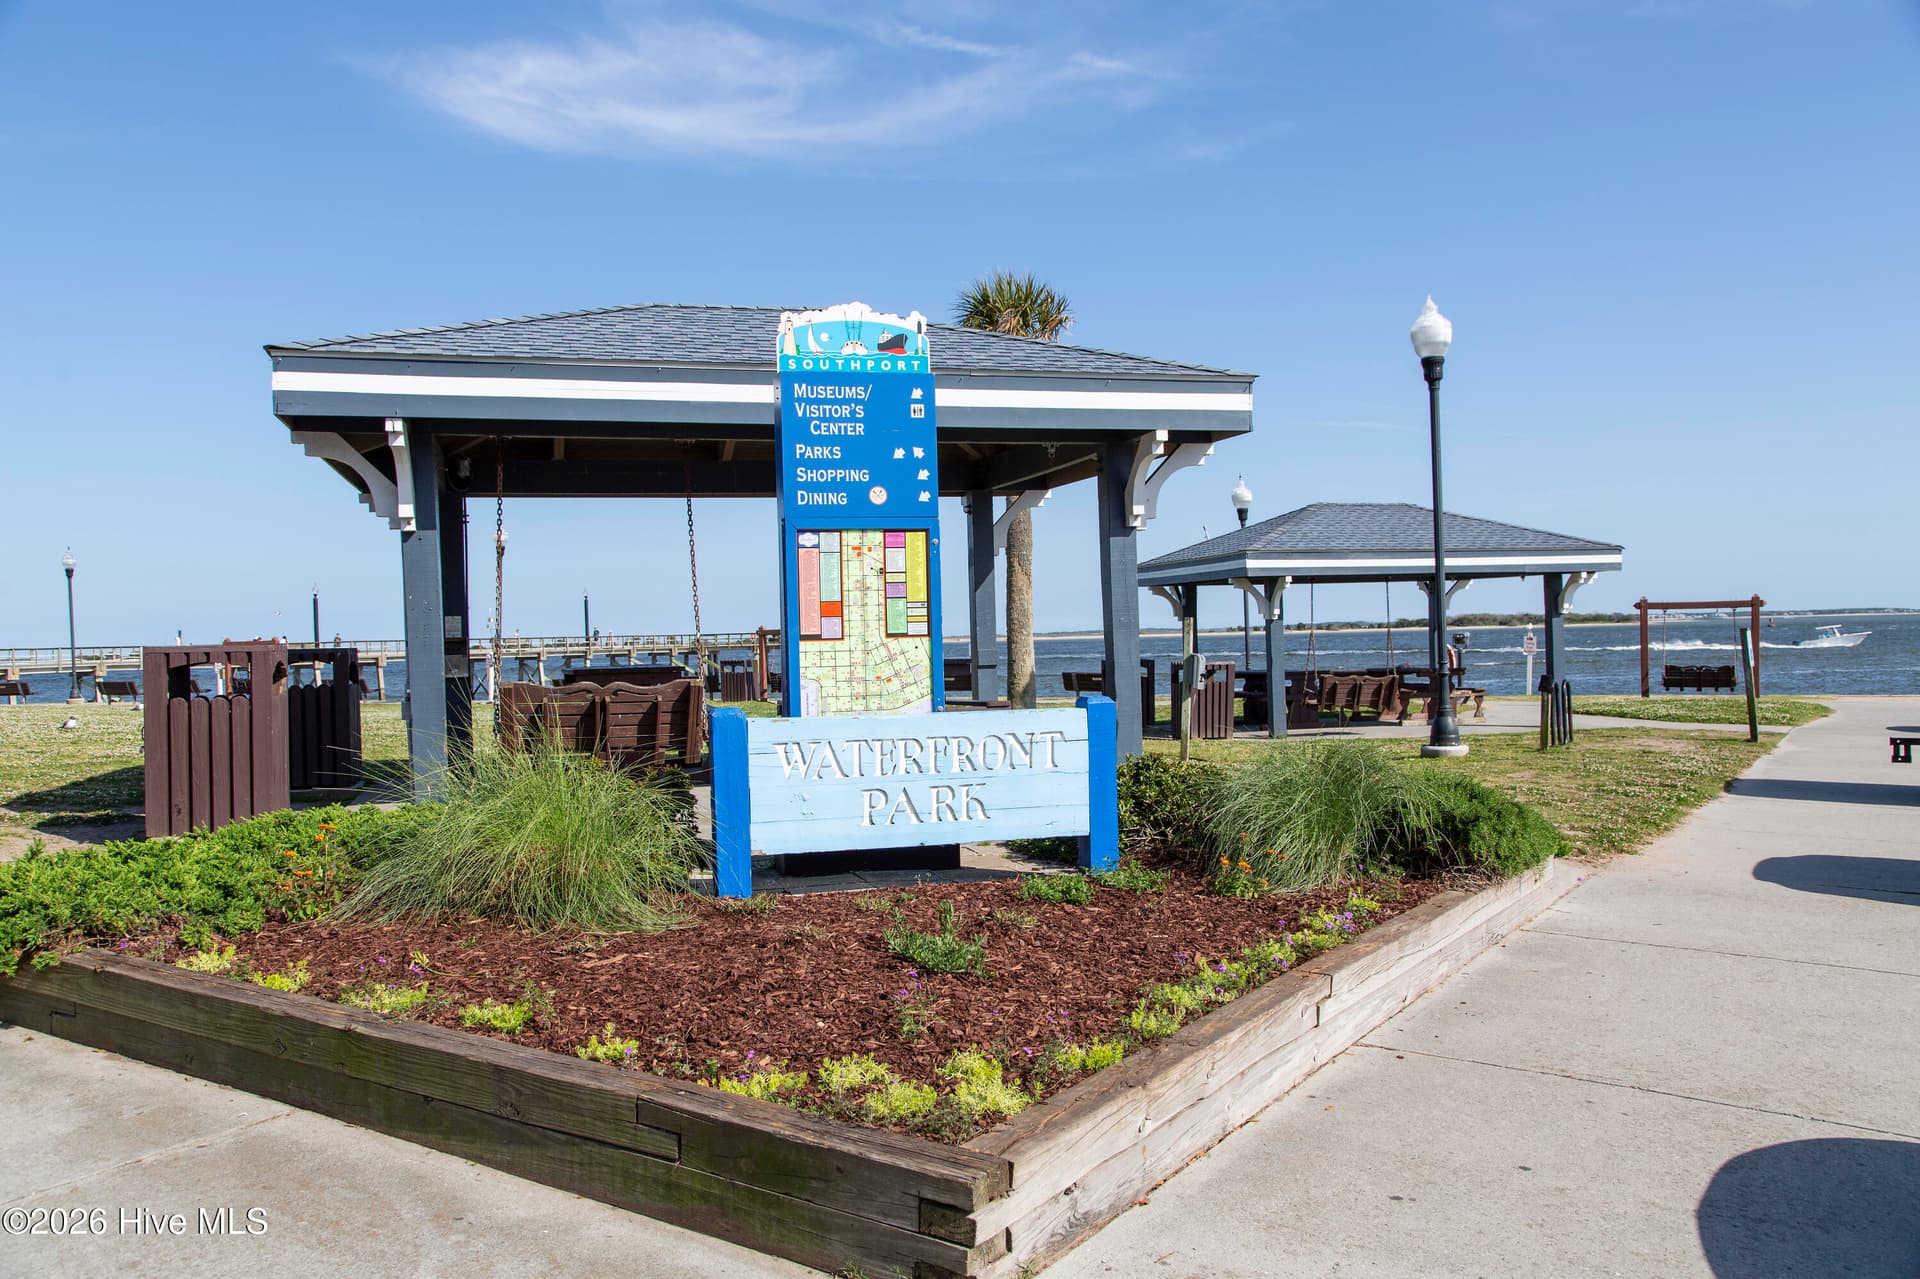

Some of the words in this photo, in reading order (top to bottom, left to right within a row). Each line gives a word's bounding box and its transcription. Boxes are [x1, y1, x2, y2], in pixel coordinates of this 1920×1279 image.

[788, 359, 921, 371] SOUTHPORT
[810, 420, 864, 435] CENTER
[795, 444, 841, 459] PARKS
[796, 467, 870, 482] SHOPPING
[797, 490, 848, 505] DINING
[772, 731, 1067, 780] WATERFRONT
[860, 782, 991, 826] PARK
